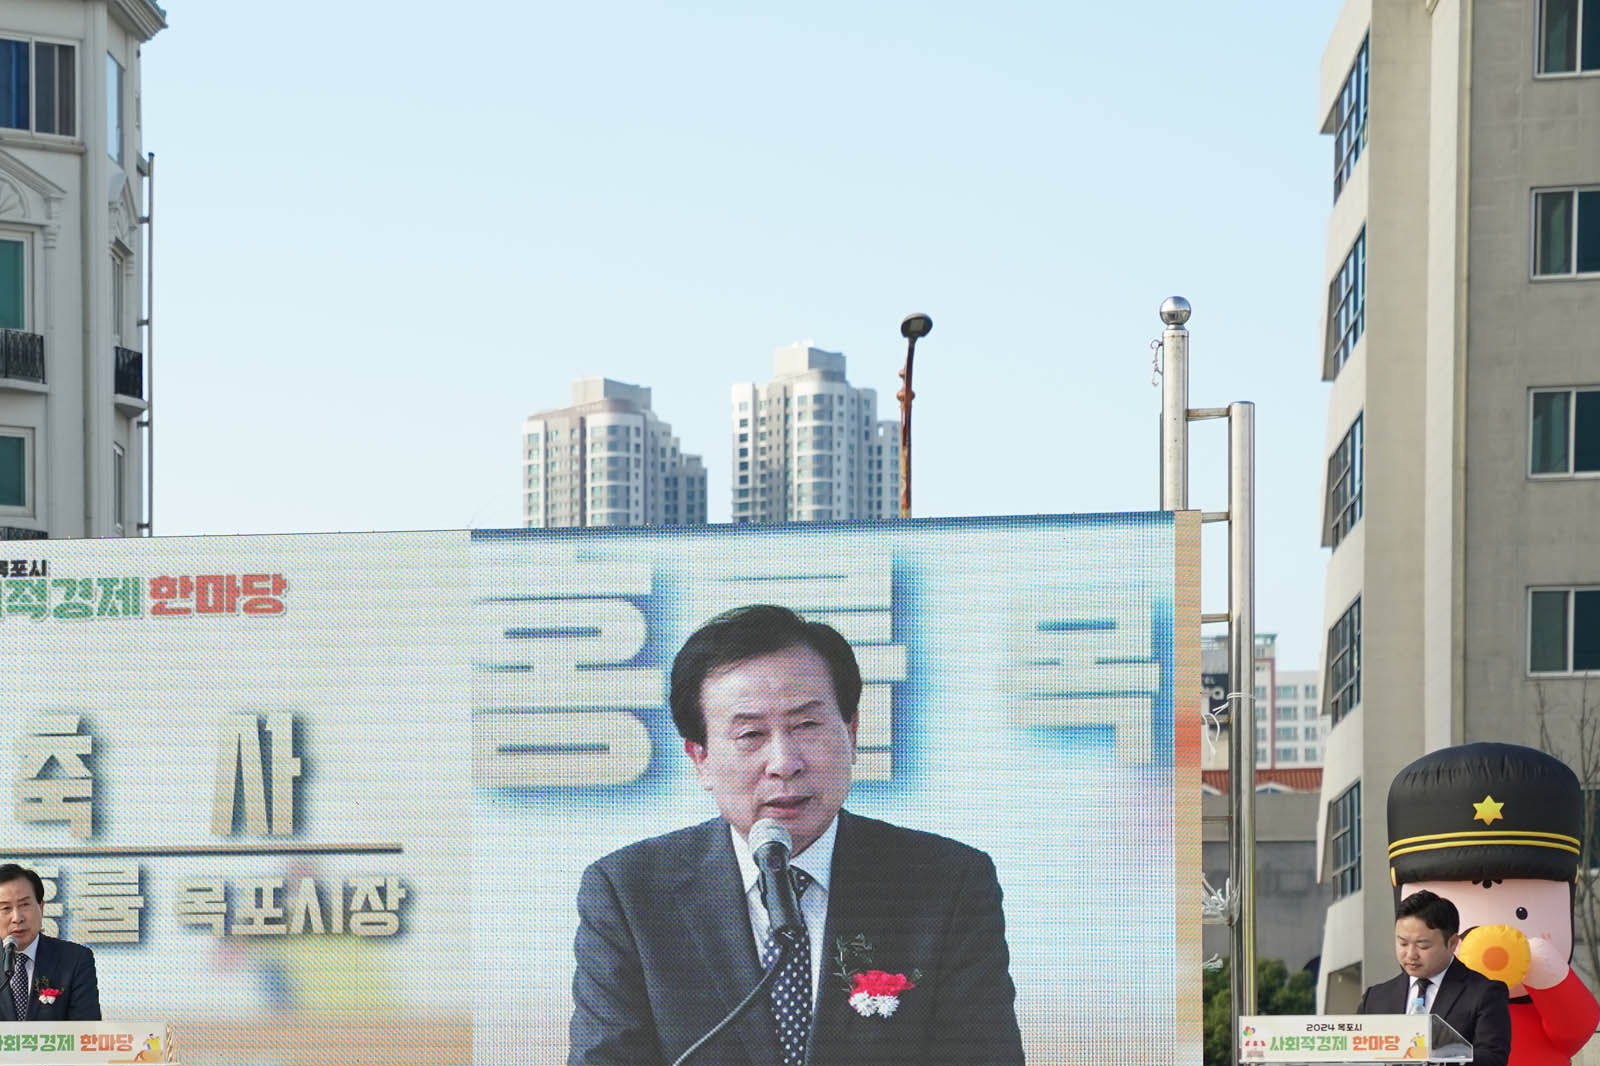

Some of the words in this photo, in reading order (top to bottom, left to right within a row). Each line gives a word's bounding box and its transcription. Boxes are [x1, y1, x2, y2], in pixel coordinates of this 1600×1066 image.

[149, 573, 288, 616] 한마당
[178, 875, 406, 938] 목포시장
[1307, 1023, 1336, 1032] 2024
[1337, 1023, 1363, 1032] 목포시
[80, 1034, 134, 1053] 한마당
[1270, 1035, 1348, 1052] 사회적경제
[1352, 1035, 1401, 1052] 한마당
